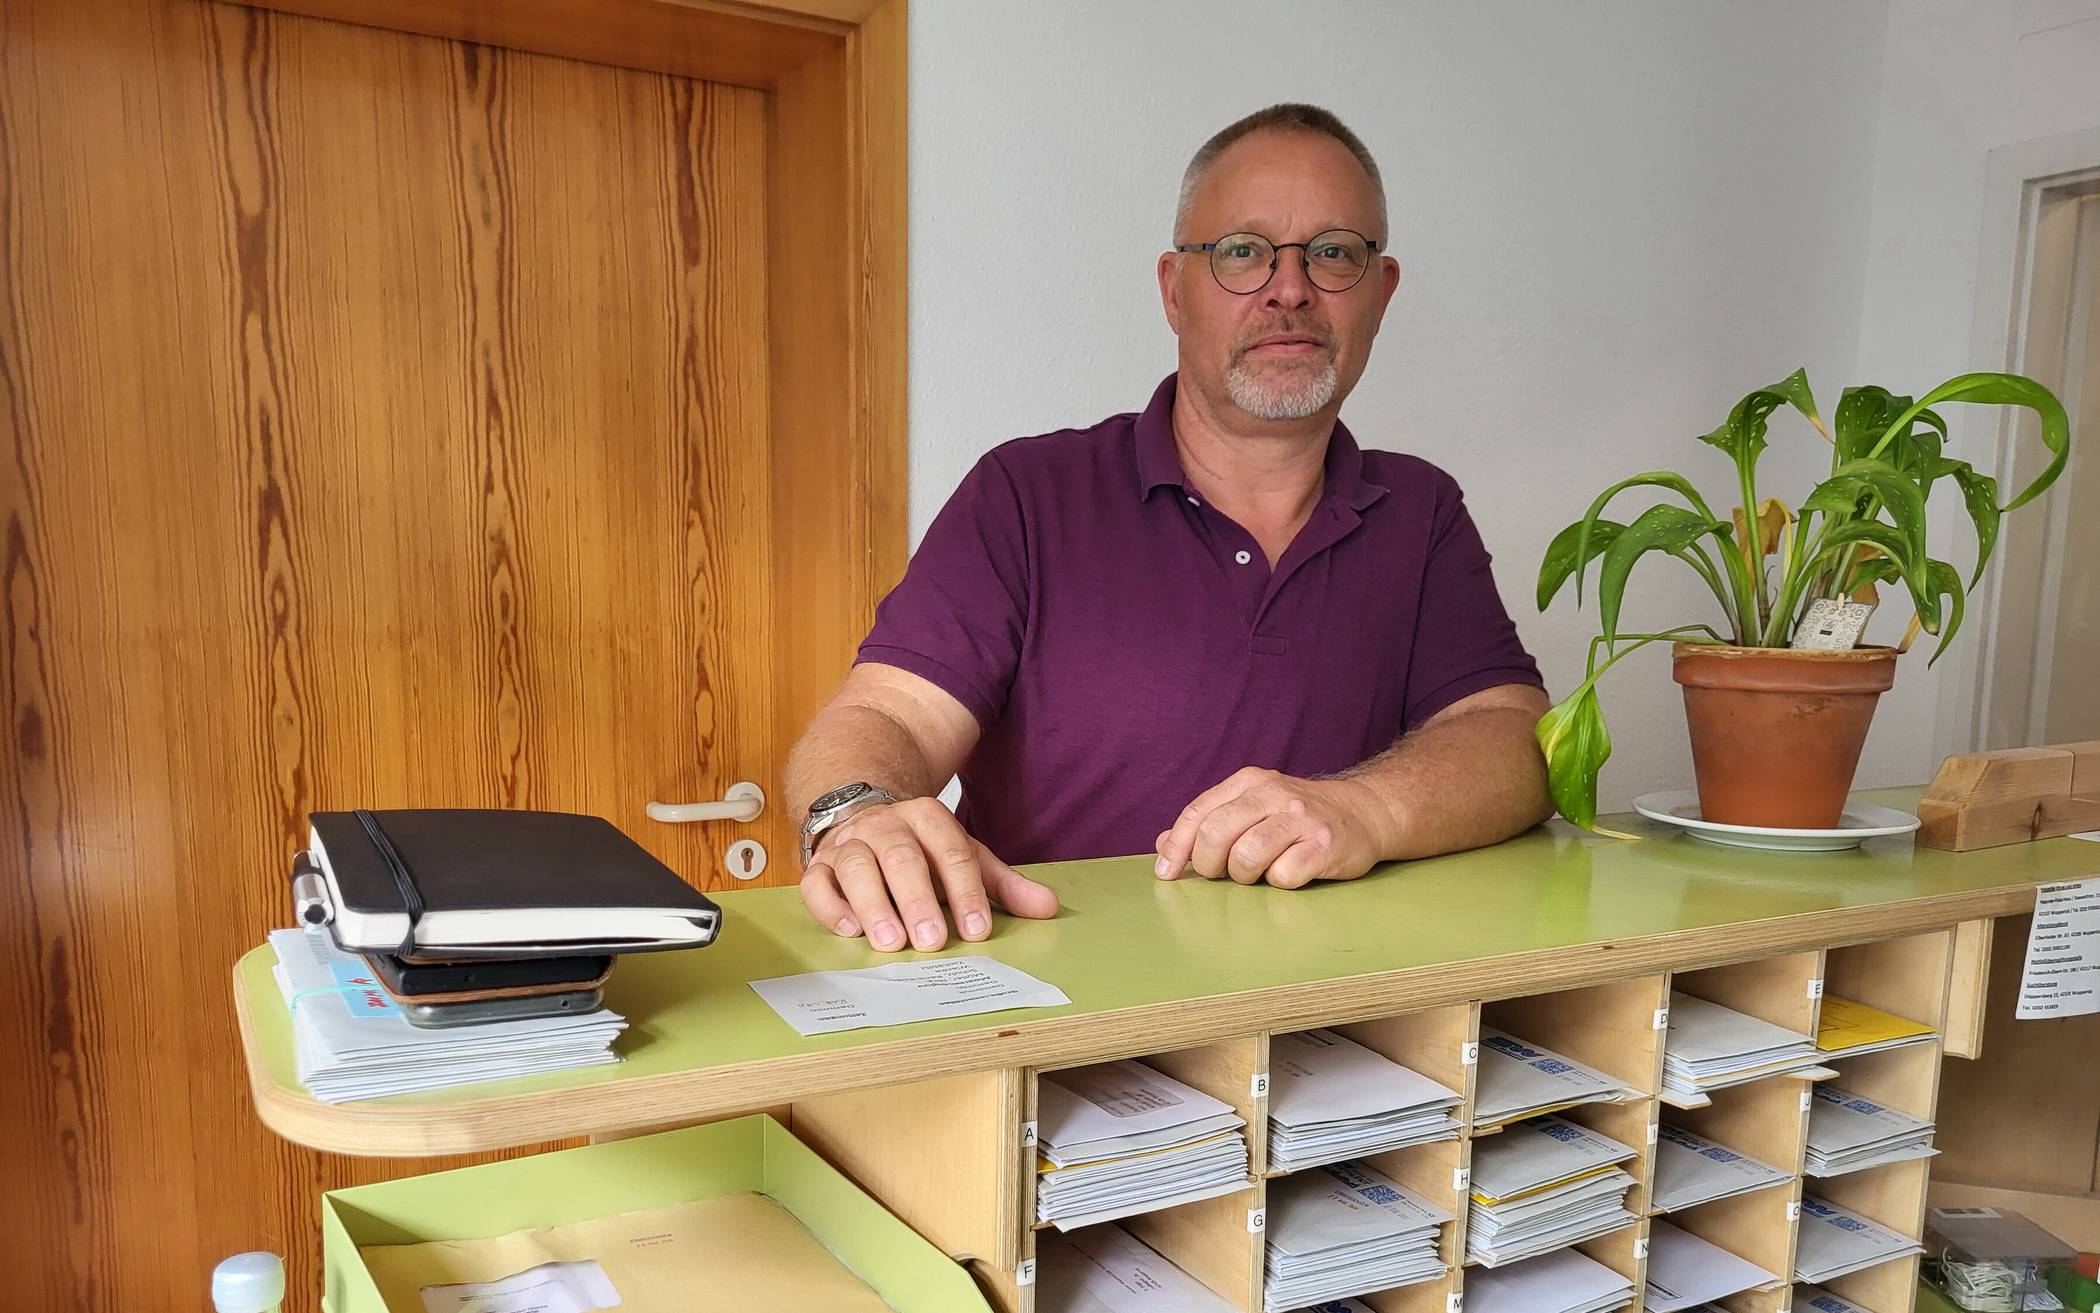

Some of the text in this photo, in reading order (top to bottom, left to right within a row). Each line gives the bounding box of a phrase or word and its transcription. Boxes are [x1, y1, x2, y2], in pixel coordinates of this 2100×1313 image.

[1815, 983, 1821, 994] E
[1661, 1014, 1667, 1024] D
[1469, 1047, 1477, 1059] C
[1258, 1079, 1266, 1092] B
[1024, 1127, 1034, 1142] A
[1460, 1175, 1469, 1186] H
[1253, 1214, 1263, 1227] G
[1642, 1243, 1648, 1253] N
[1024, 1264, 1033, 1279] F
[1453, 1298, 1463, 1309] M
